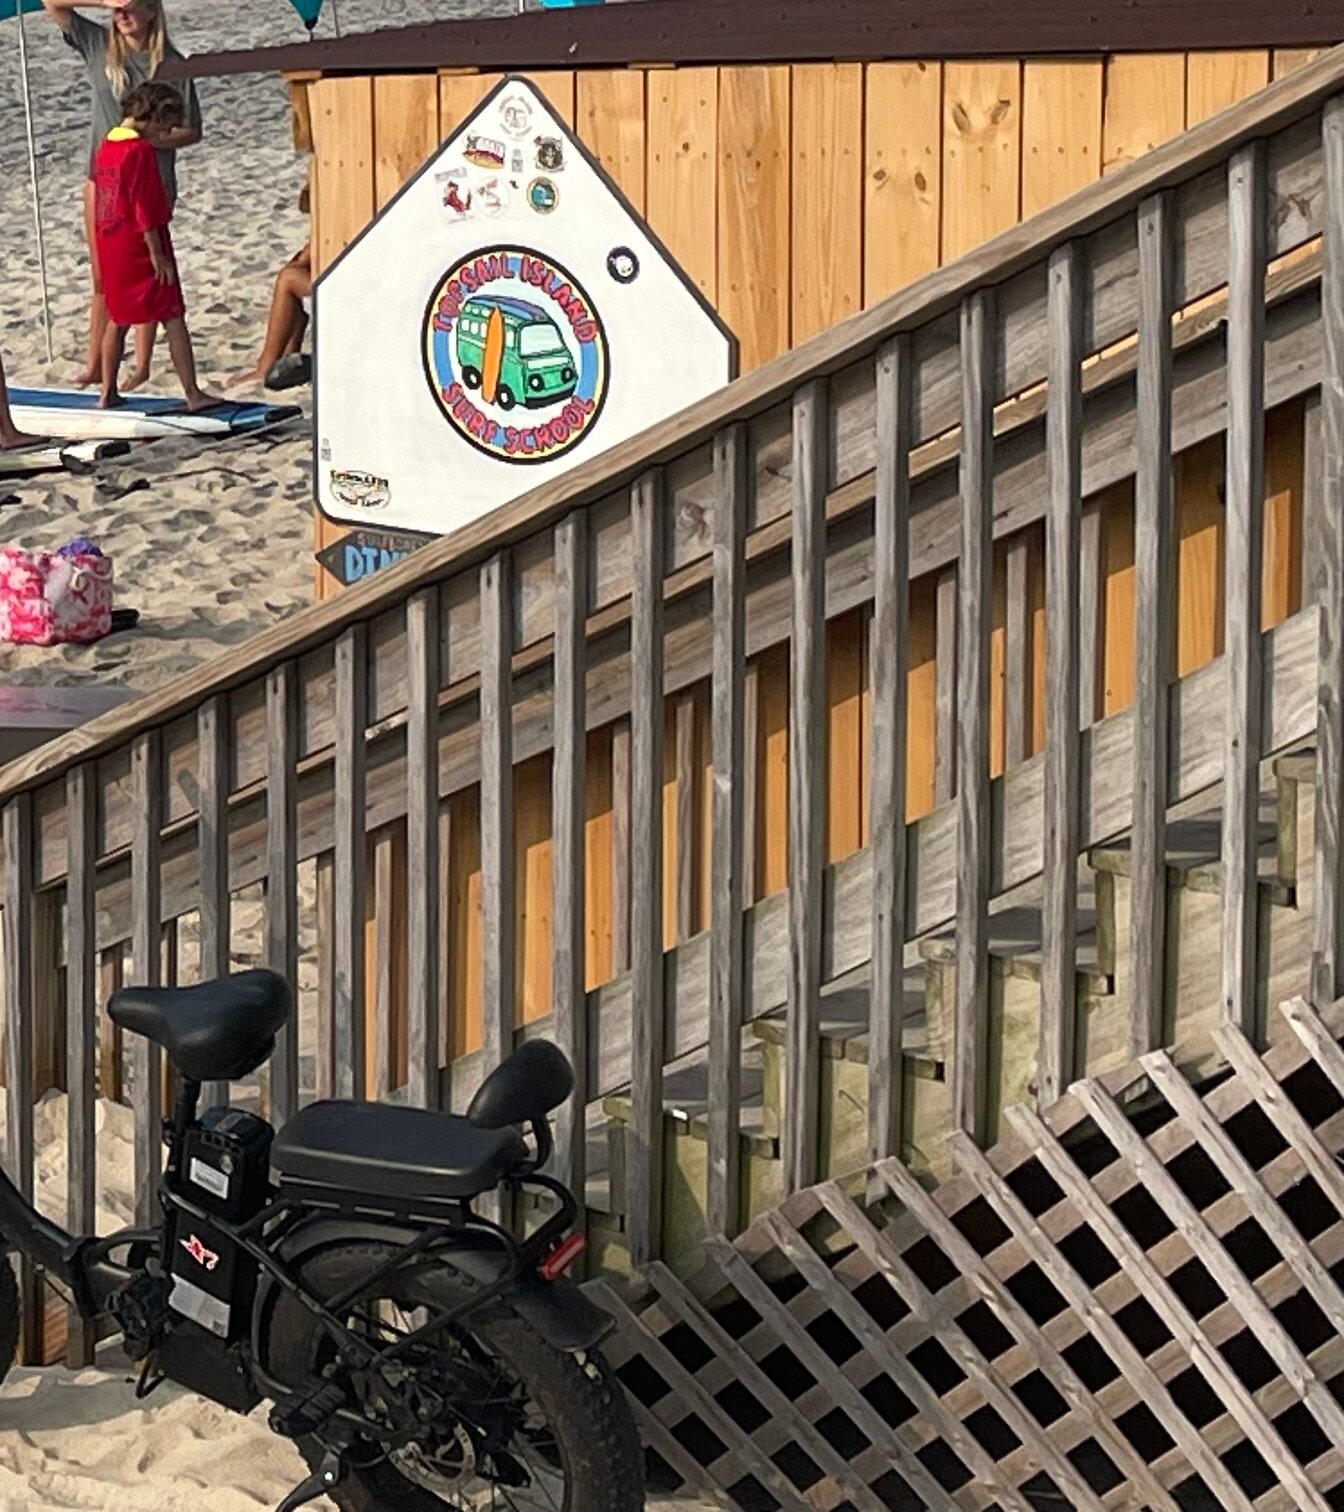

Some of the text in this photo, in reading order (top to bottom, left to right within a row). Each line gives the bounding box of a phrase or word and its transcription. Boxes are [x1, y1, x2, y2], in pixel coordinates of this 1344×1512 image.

[432, 253, 599, 344] TOPSAIL ISLAND
[441, 381, 596, 455] SURF SCHOOL
